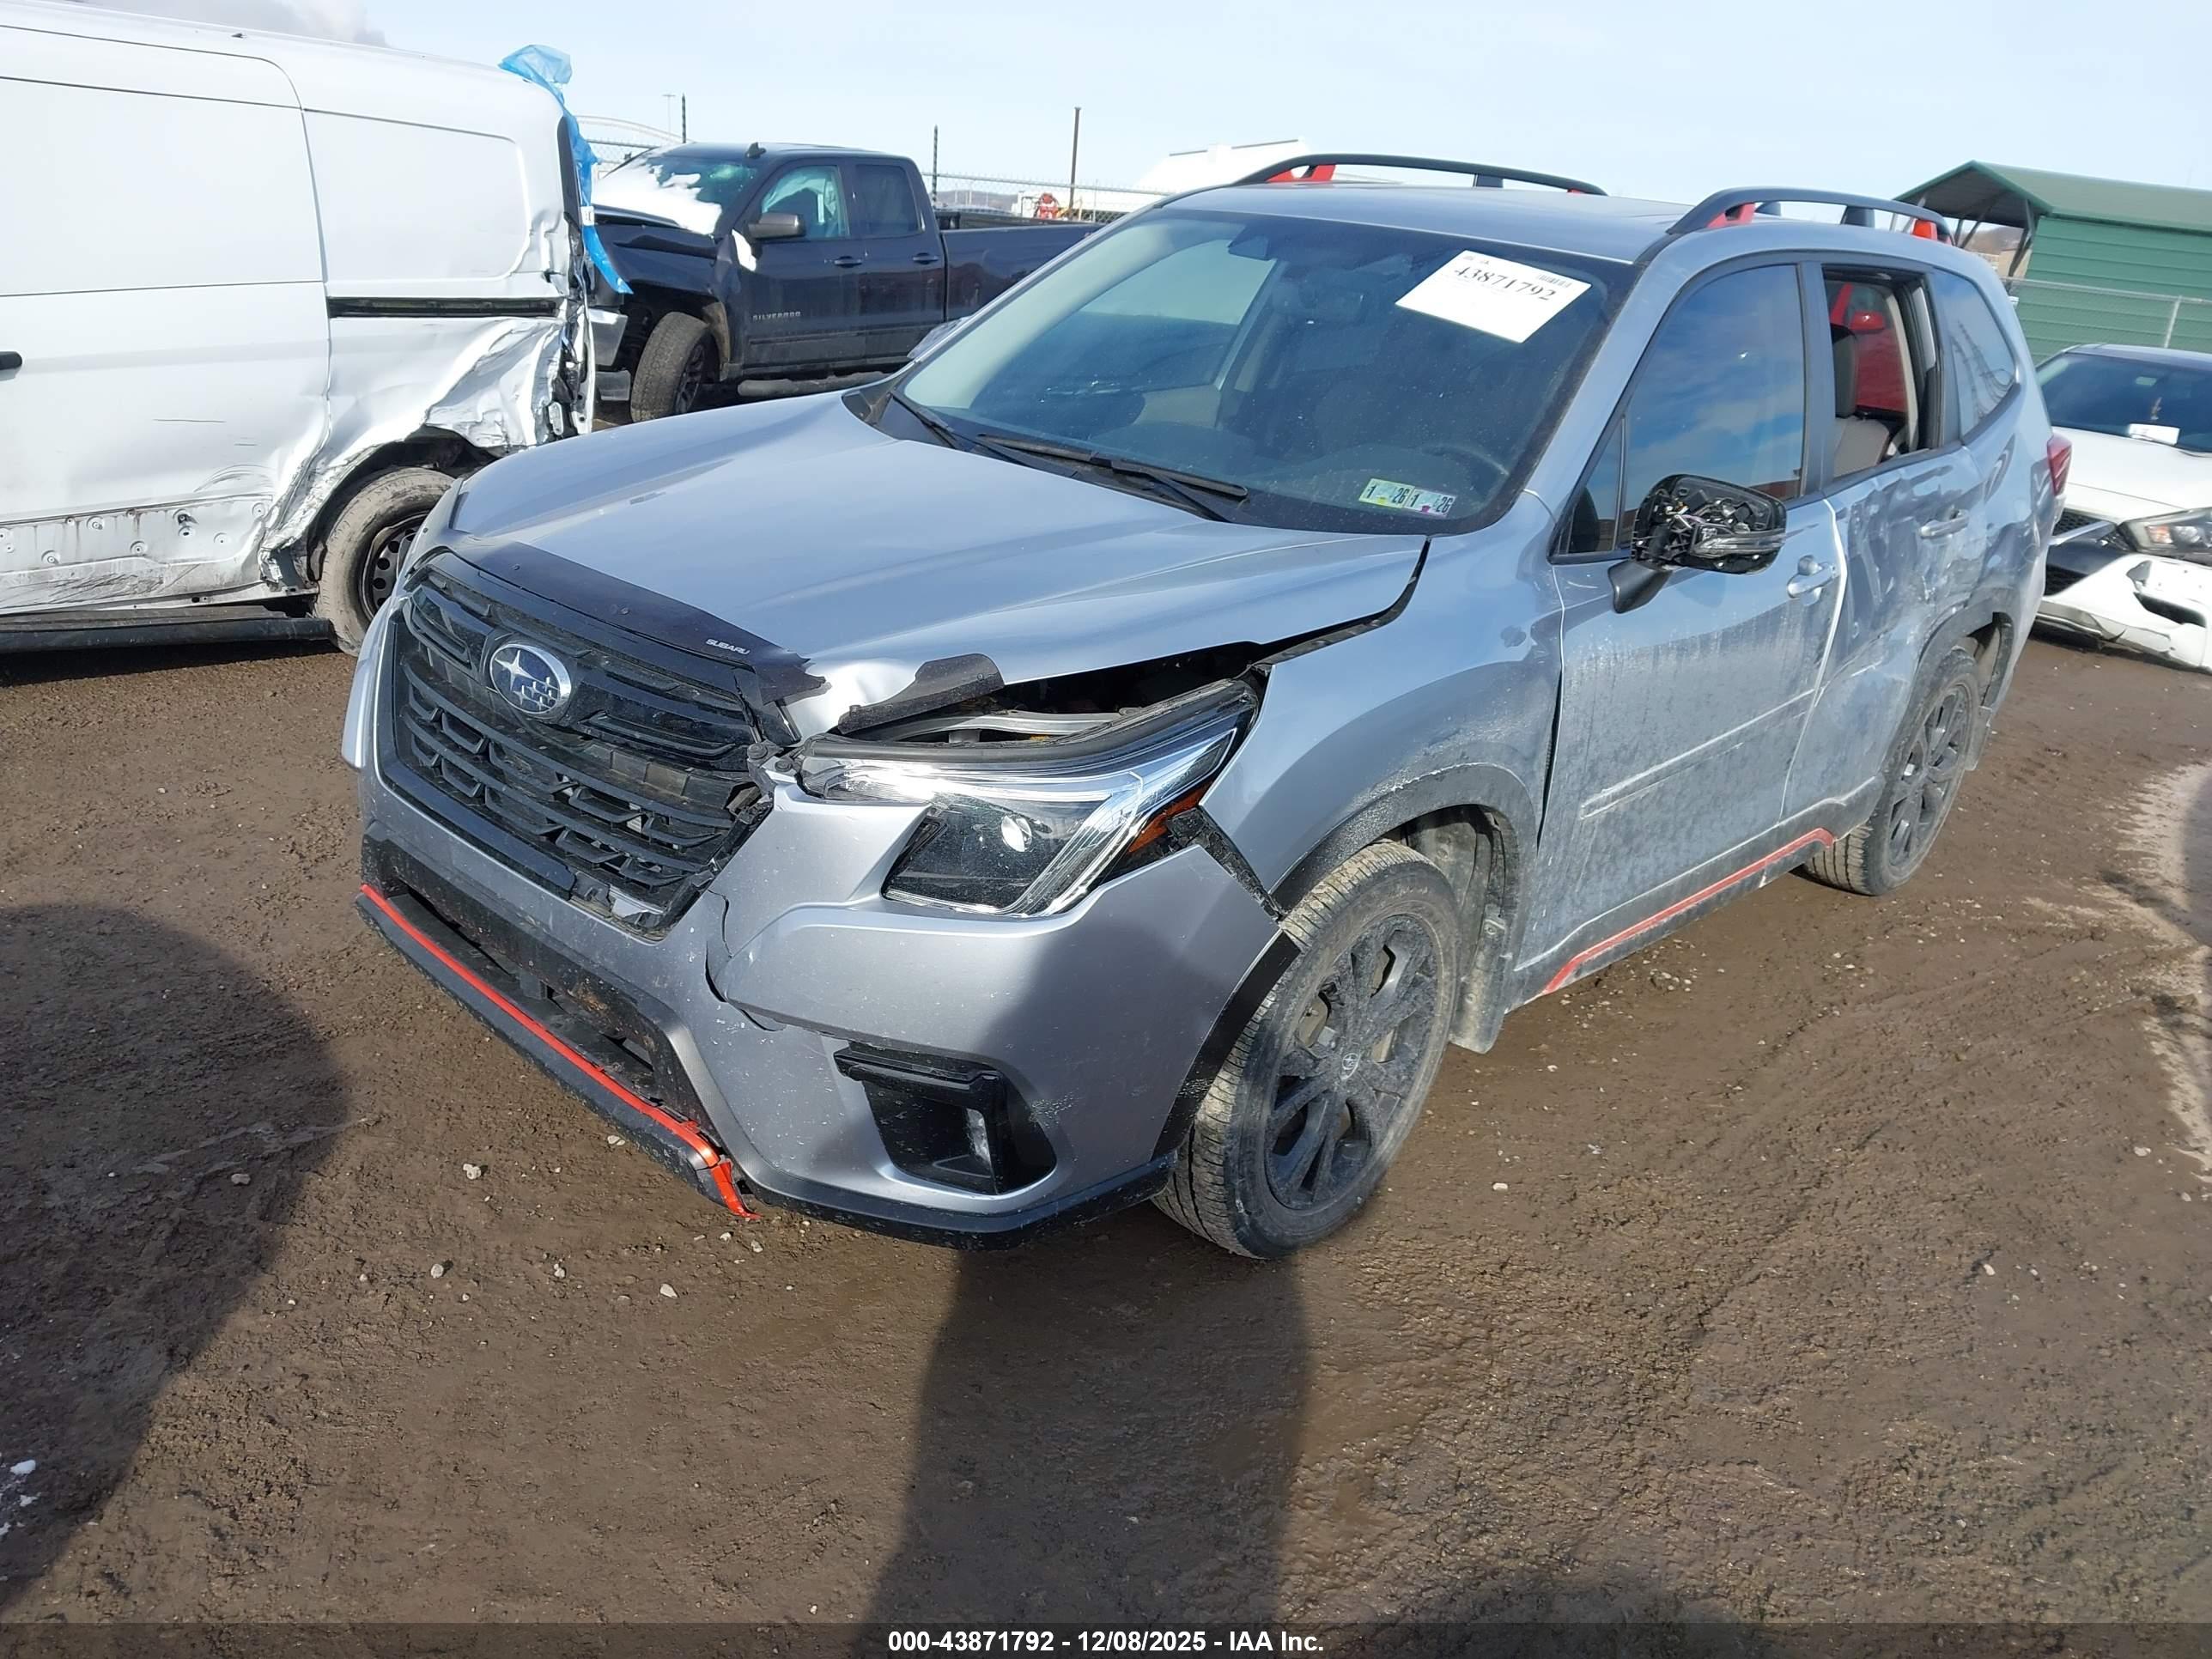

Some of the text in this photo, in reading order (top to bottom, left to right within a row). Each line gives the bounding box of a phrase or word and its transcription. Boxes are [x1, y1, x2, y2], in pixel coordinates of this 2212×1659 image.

[1454, 266, 1557, 301] 43871792
[1392, 487, 1410, 504] 26
[1436, 496, 1454, 514] 26
[706, 639, 750, 654] SUBARU
